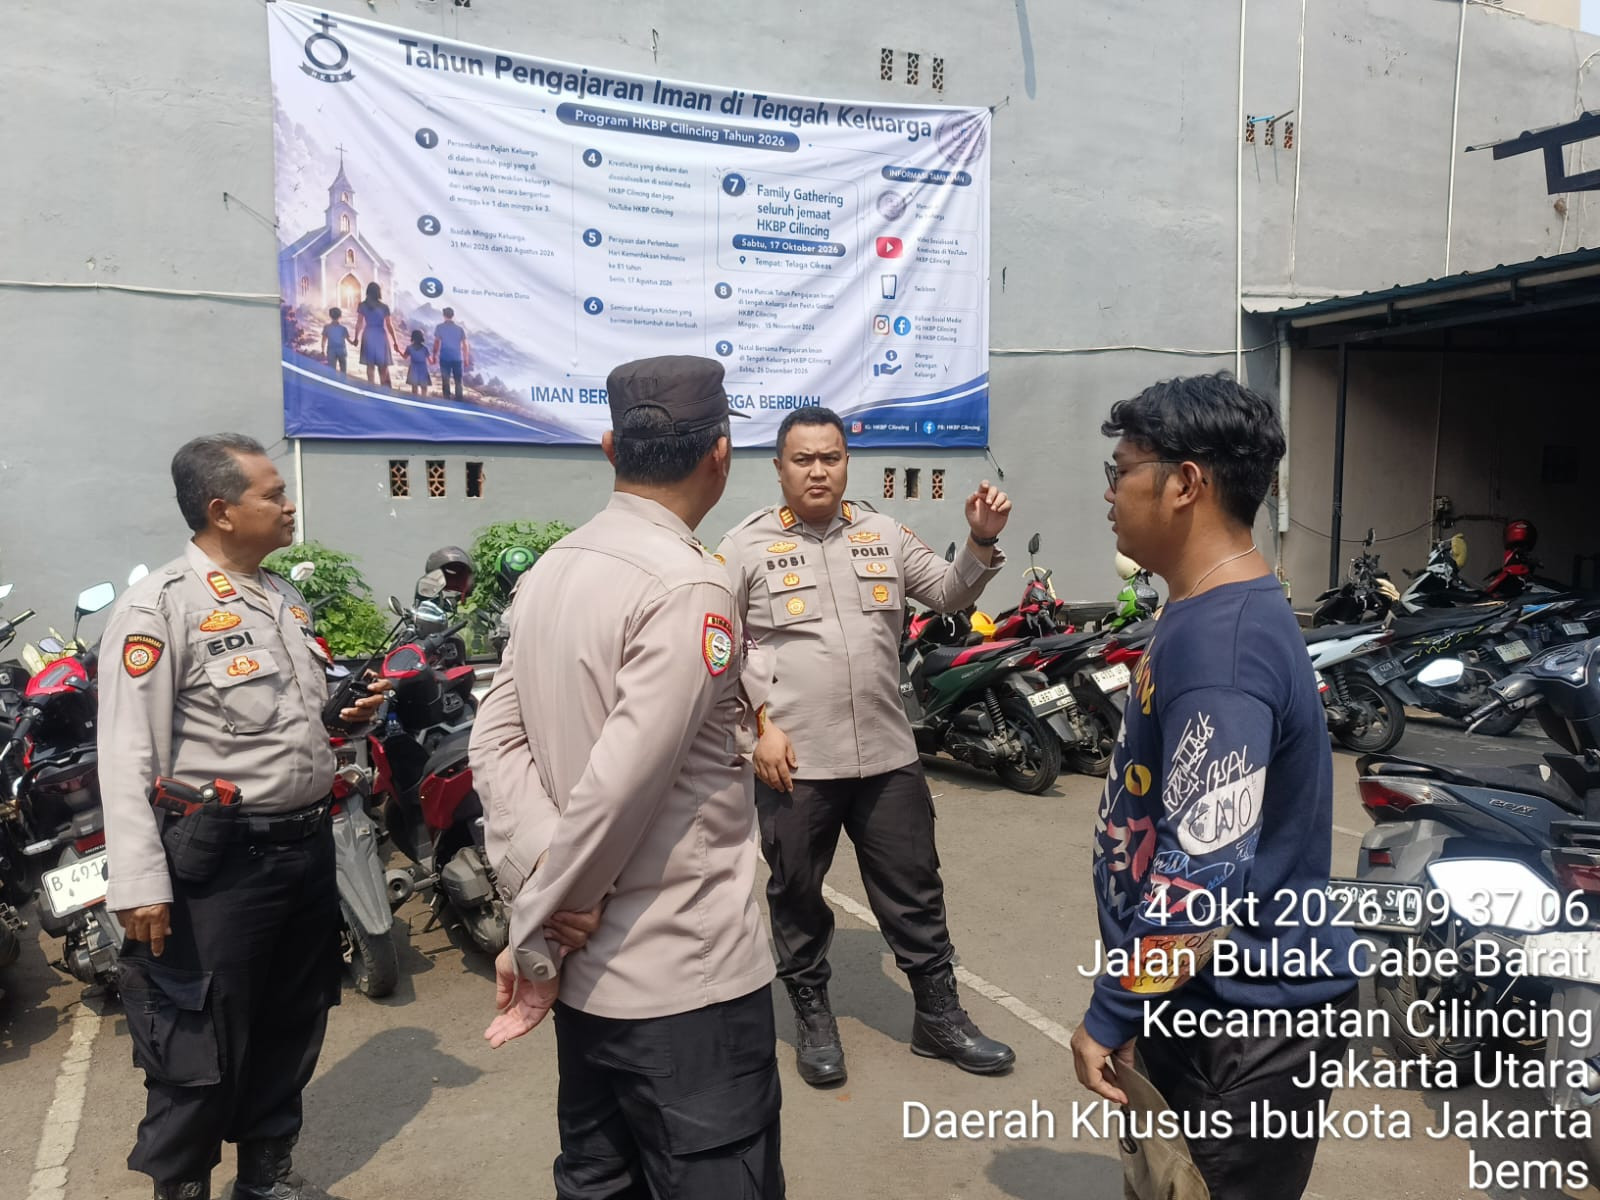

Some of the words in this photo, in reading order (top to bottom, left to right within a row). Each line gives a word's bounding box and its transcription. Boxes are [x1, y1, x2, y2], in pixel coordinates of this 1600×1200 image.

[398, 39, 484, 76] Tahun
[495, 55, 644, 100] Pengajaran
[653, 80, 711, 111] Iman
[720, 90, 743, 116] di
[751, 93, 828, 128] Tengah
[837, 105, 932, 142] Keluarga
[575, 109, 629, 127] Program
[633, 118, 667, 130] HKBP
[671, 122, 719, 141] Cilincing
[722, 129, 754, 144] Tahun
[758, 134, 785, 147] 2026
[490, 144, 509, 154] Pujian
[511, 147, 538, 157] Keluarga
[456, 155, 474, 163] dalam
[499, 160, 512, 168] pagi
[513, 162, 529, 171] yang
[608, 160, 638, 169] Kreativitas
[640, 163, 653, 172] yang
[655, 164, 677, 173] direkam
[448, 168, 473, 177] lakukan
[475, 170, 489, 178] oleh
[462, 184, 481, 193] setiap
[498, 188, 517, 196] secara
[674, 180, 691, 189] media
[729, 178, 739, 192] 7
[626, 188, 649, 199] Cilincing
[662, 192, 674, 201] juga
[757, 183, 790, 202] Family
[793, 188, 843, 208] Gathering
[457, 197, 480, 207] minggu
[497, 200, 509, 208] dan
[511, 202, 534, 212] minggu
[608, 203, 632, 212] YouTube
[633, 205, 650, 213] HKBP
[651, 207, 674, 217] Cilincing
[757, 202, 794, 217] seluruh
[797, 206, 831, 220] jemaat
[472, 230, 496, 239] Minggu
[498, 232, 525, 242] Keluarga
[757, 219, 786, 233] HKBP
[789, 222, 830, 240] Cilincing
[608, 235, 634, 245] Perayaan
[635, 237, 646, 245] dan
[741, 238, 767, 249] Sabtu,
[770, 240, 780, 249] 17
[782, 241, 815, 253] Oktober
[818, 245, 839, 254] 2026
[514, 247, 538, 256] Agustus
[539, 249, 555, 257] 2026
[621, 250, 659, 259] Kemerdekaan
[660, 253, 685, 262] Indonesia
[755, 258, 782, 268] Tempat:
[785, 260, 807, 270] Telaga
[636, 277, 658, 287] Agustus
[452, 286, 469, 294] Bazar
[471, 288, 482, 296] dan
[484, 290, 513, 298] Pencarian
[737, 287, 754, 295] Pesta
[775, 289, 790, 297] Tahun
[791, 290, 819, 299] Pengajaran
[610, 303, 633, 311] Seminar
[634, 305, 658, 314] Keluarga
[659, 307, 678, 315] Kristen
[679, 309, 692, 317] yang
[765, 301, 788, 309] Keluarga
[799, 302, 815, 310] Pesta
[755, 310, 778, 319] Cilincing
[633, 318, 663, 327] bertumbuh
[664, 319, 674, 327] dan
[676, 320, 697, 329] berbuah
[755, 344, 778, 353] Bersama
[779, 345, 808, 355] Pengajaran
[746, 355, 765, 363] Tengah
[766, 356, 790, 365] Keluarga
[531, 386, 574, 403] IMAN
[759, 395, 821, 409] BERBUAH
[851, 546, 889, 558] POLRI
[766, 554, 806, 571] BOBI
[208, 631, 256, 656] EDI
[51, 876, 63, 891] B
